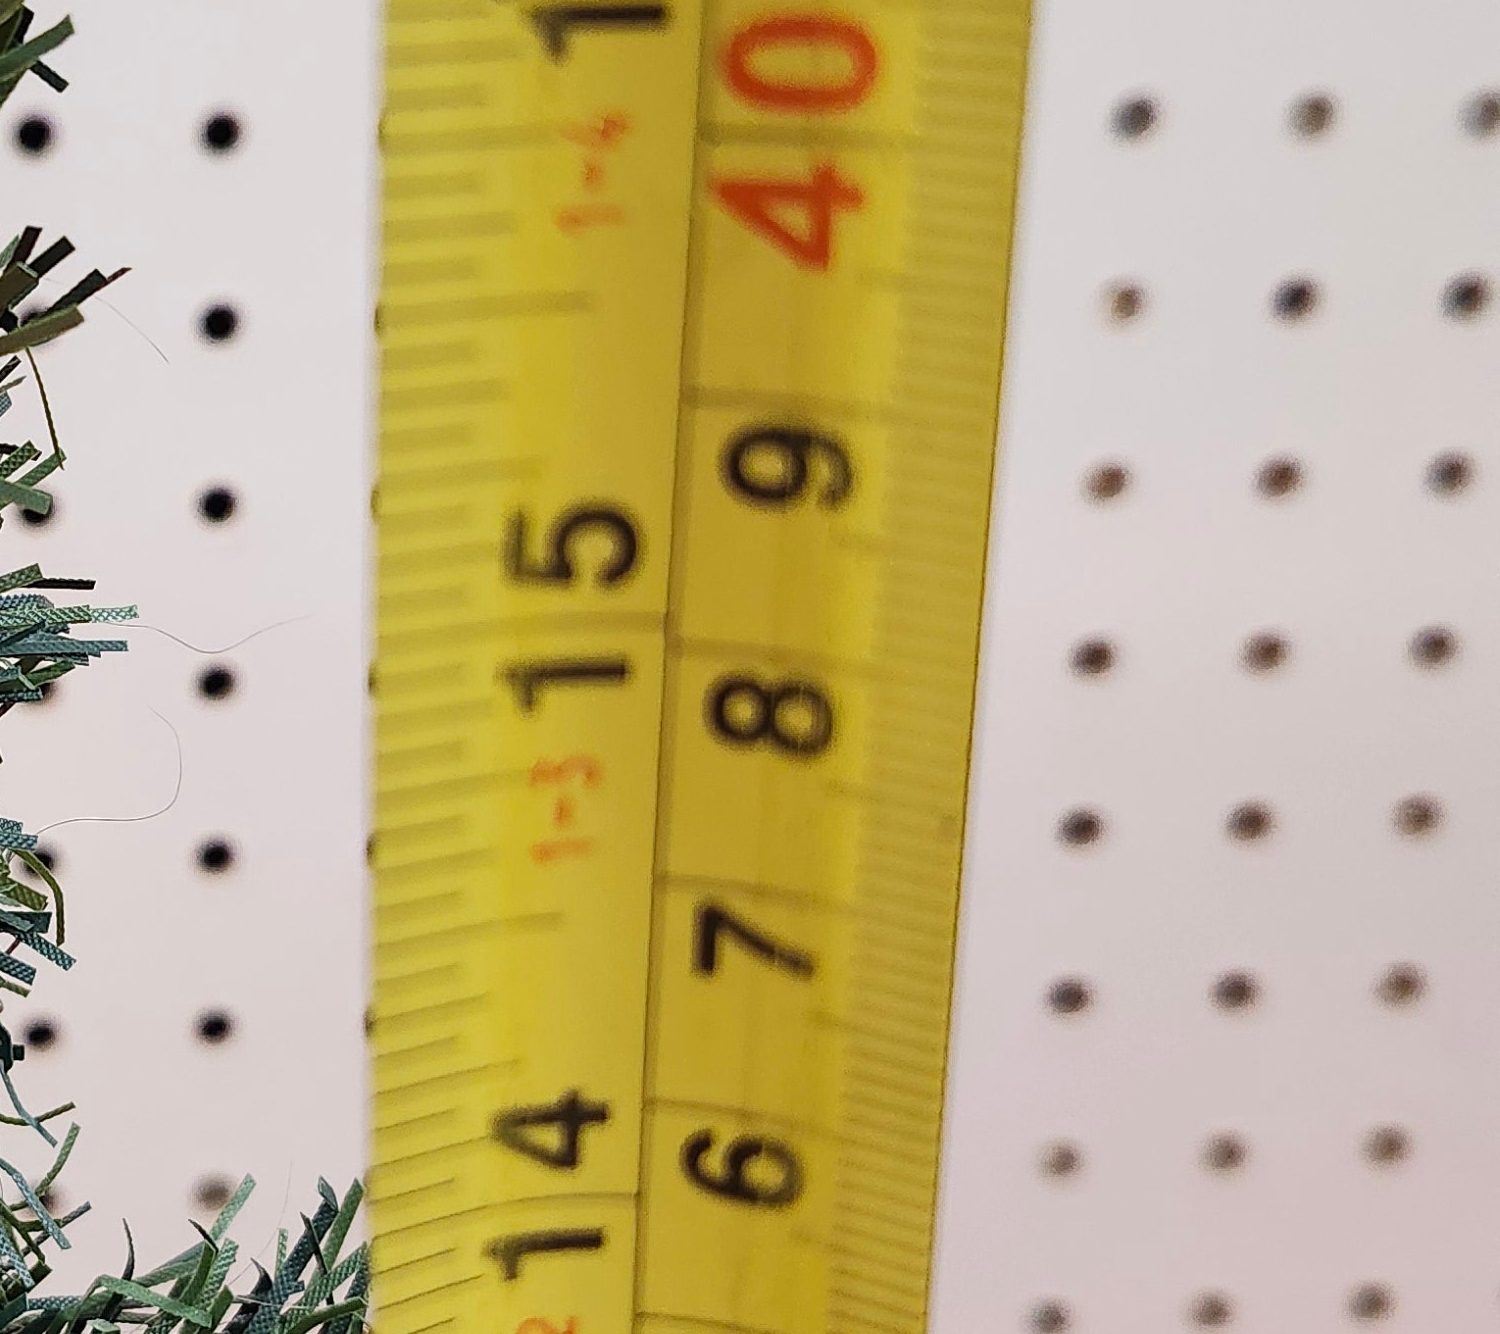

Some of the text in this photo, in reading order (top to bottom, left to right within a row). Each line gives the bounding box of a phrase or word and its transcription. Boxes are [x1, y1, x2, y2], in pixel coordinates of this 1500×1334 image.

[708, 12, 880, 272] 40
[720, 423, 858, 510] 9
[498, 499, 642, 713] 15
[708, 674, 834, 758] 8
[692, 900, 816, 980] 7
[481, 1089, 610, 1282] 14
[680, 1128, 805, 1209] 6
